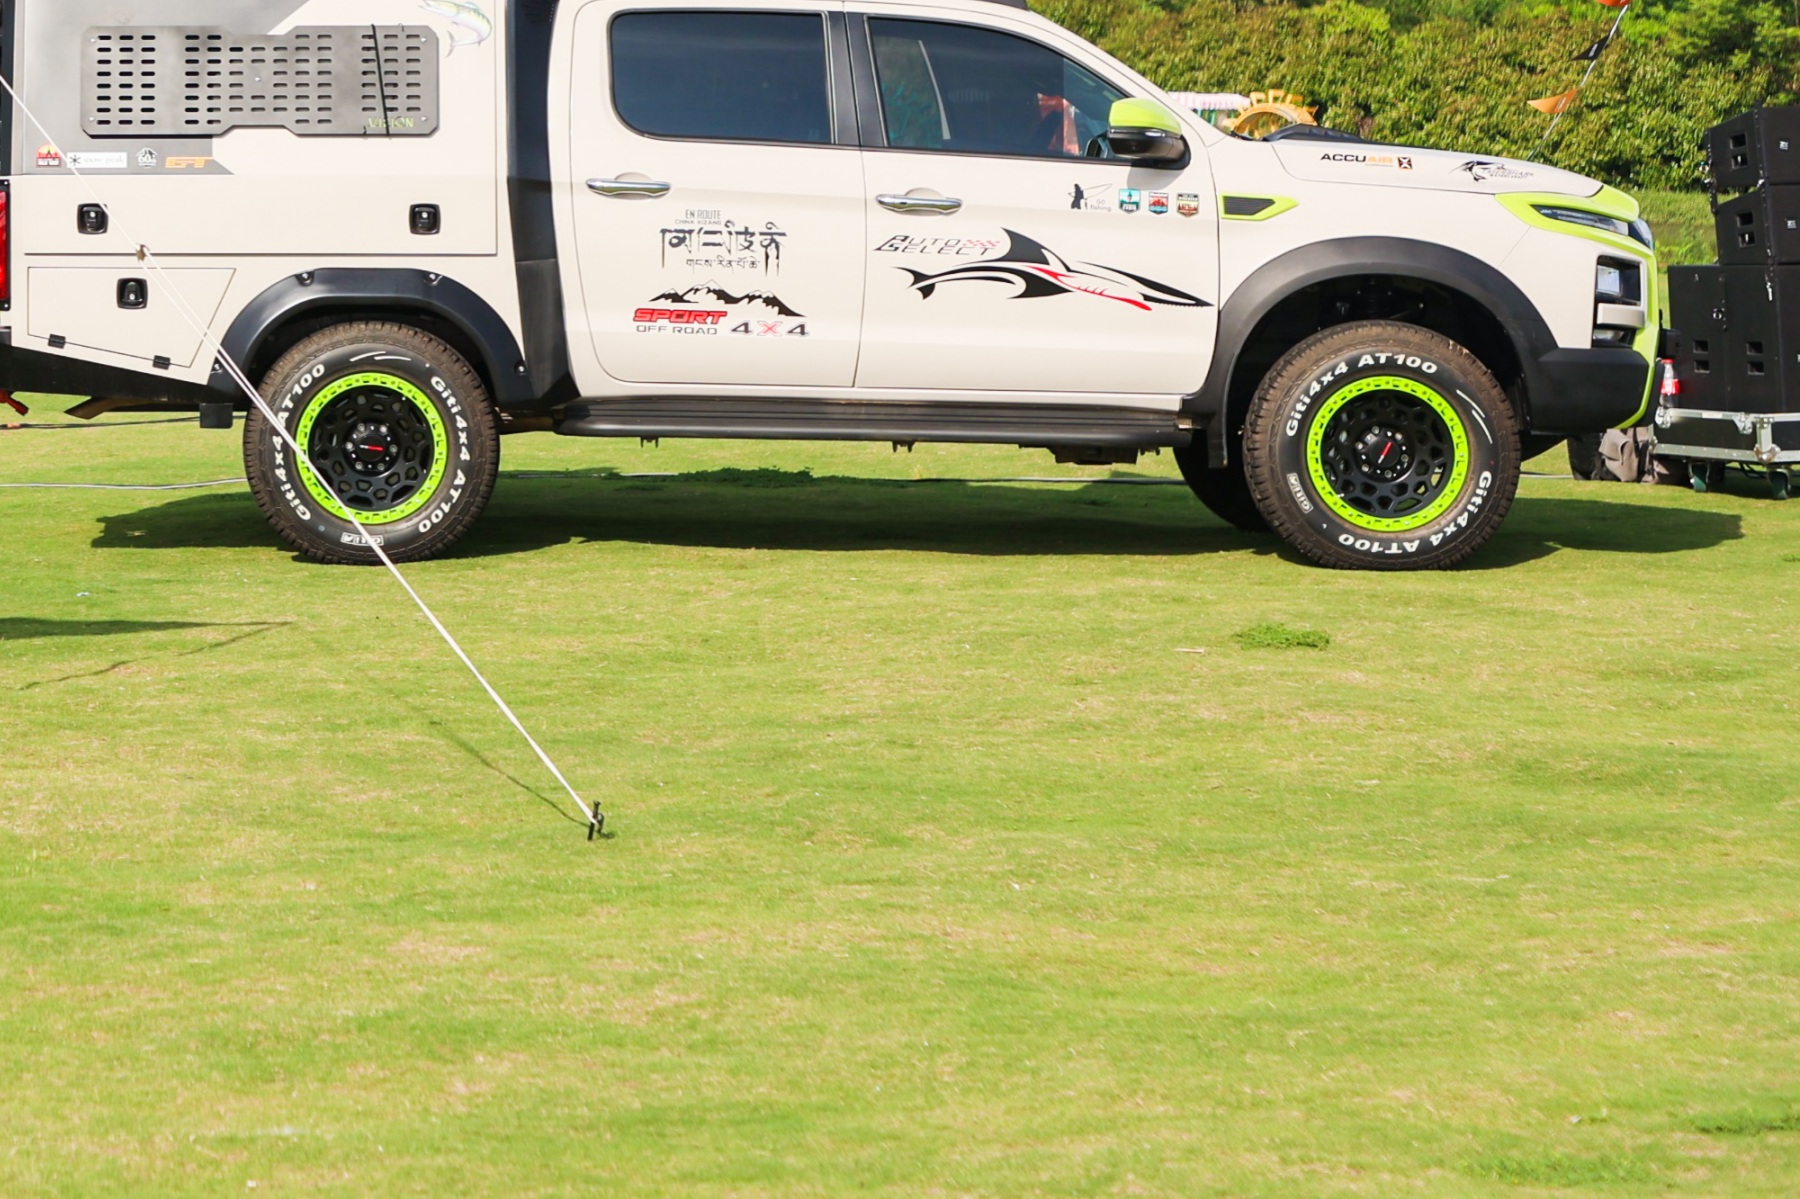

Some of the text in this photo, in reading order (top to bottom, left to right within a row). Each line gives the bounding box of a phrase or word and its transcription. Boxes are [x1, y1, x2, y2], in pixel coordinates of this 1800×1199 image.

[685, 209, 721, 220] EN ROUTE
[633, 308, 728, 325] SPORT
[636, 325, 718, 335] OFF ROAD
[1286, 352, 1438, 437] Giti4x4 AT100
[418, 376, 471, 533] Giti4x4 AT100
[1338, 471, 1492, 554] Giti4x4 AT100
